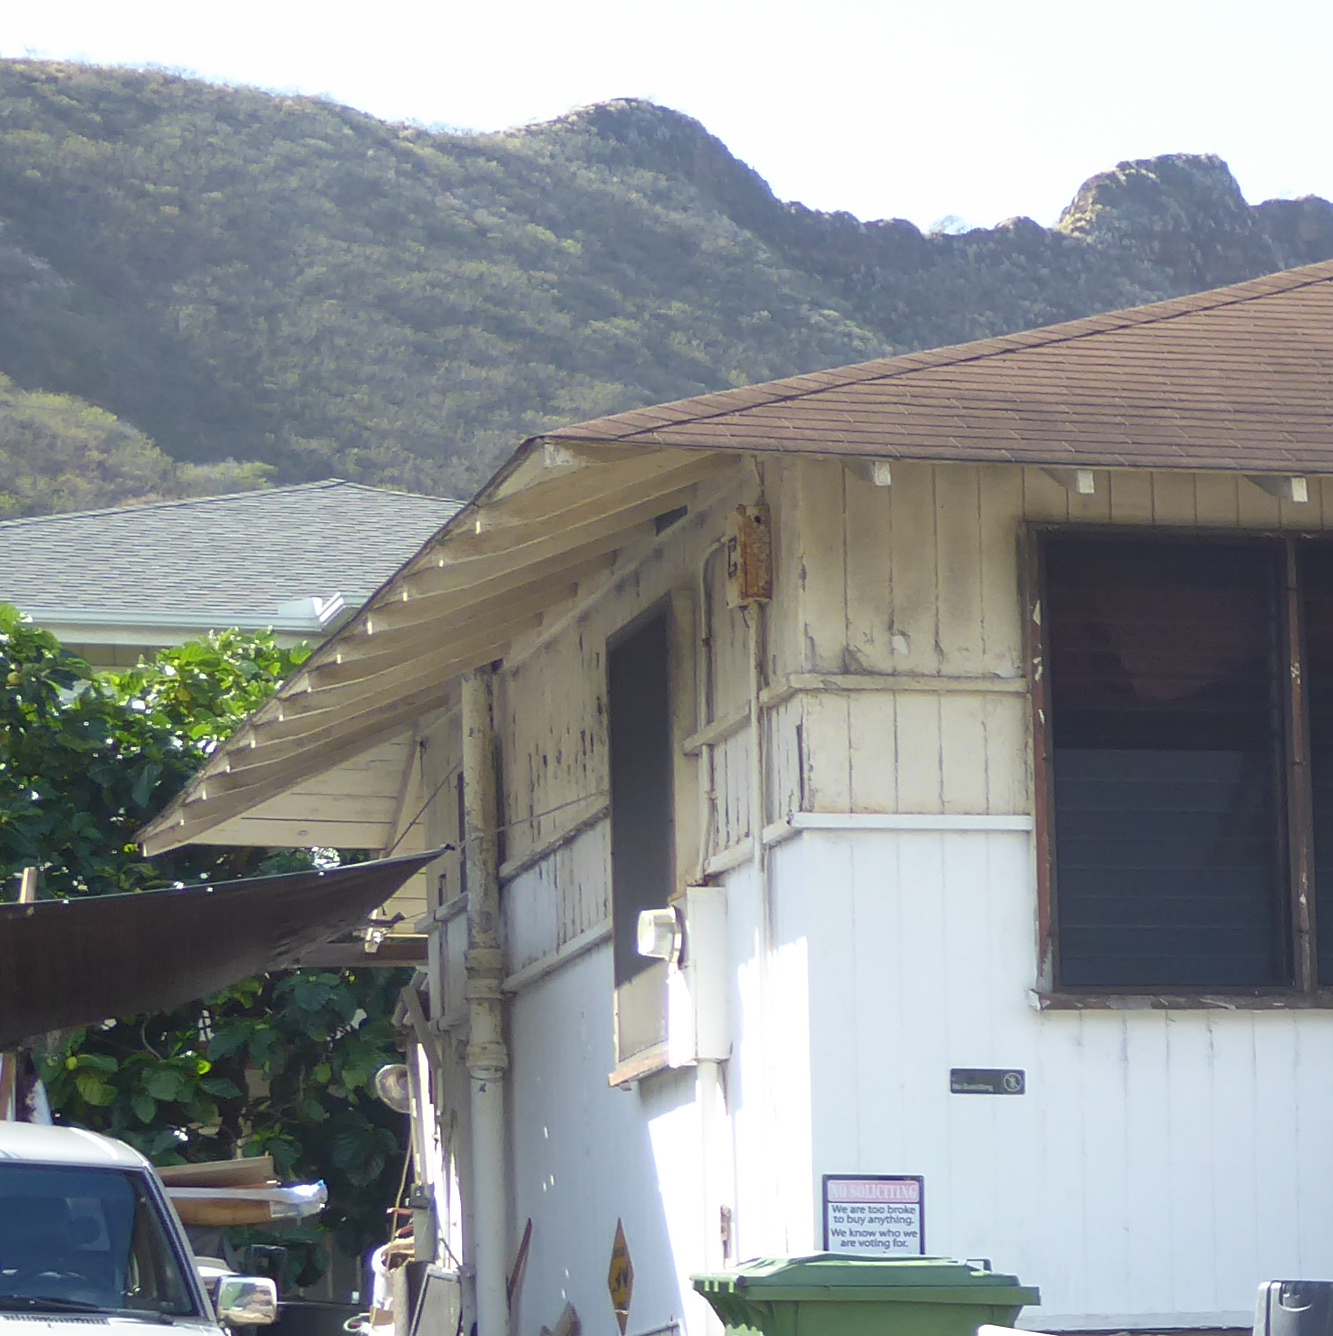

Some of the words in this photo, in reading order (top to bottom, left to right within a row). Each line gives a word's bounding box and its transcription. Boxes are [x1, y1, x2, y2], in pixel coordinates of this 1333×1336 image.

[830, 1184, 846, 1199] NO
[850, 1184, 917, 1199] SOLICITING
[832, 1205, 848, 1214] We
[850, 1206, 866, 1214] are
[868, 1205, 885, 1214] too
[887, 1205, 916, 1214] broke
[834, 1215, 844, 1224] to
[847, 1215, 865, 1226] buy
[868, 1215, 914, 1226] anything.
[831, 1228, 846, 1237] We
[849, 1228, 876, 1237] know
[879, 1228, 900, 1237] who
[903, 1230, 917, 1238] we
[841, 1239, 856, 1247] are
[859, 1238, 890, 1249] voting
[893, 1238, 908, 1247] for.
